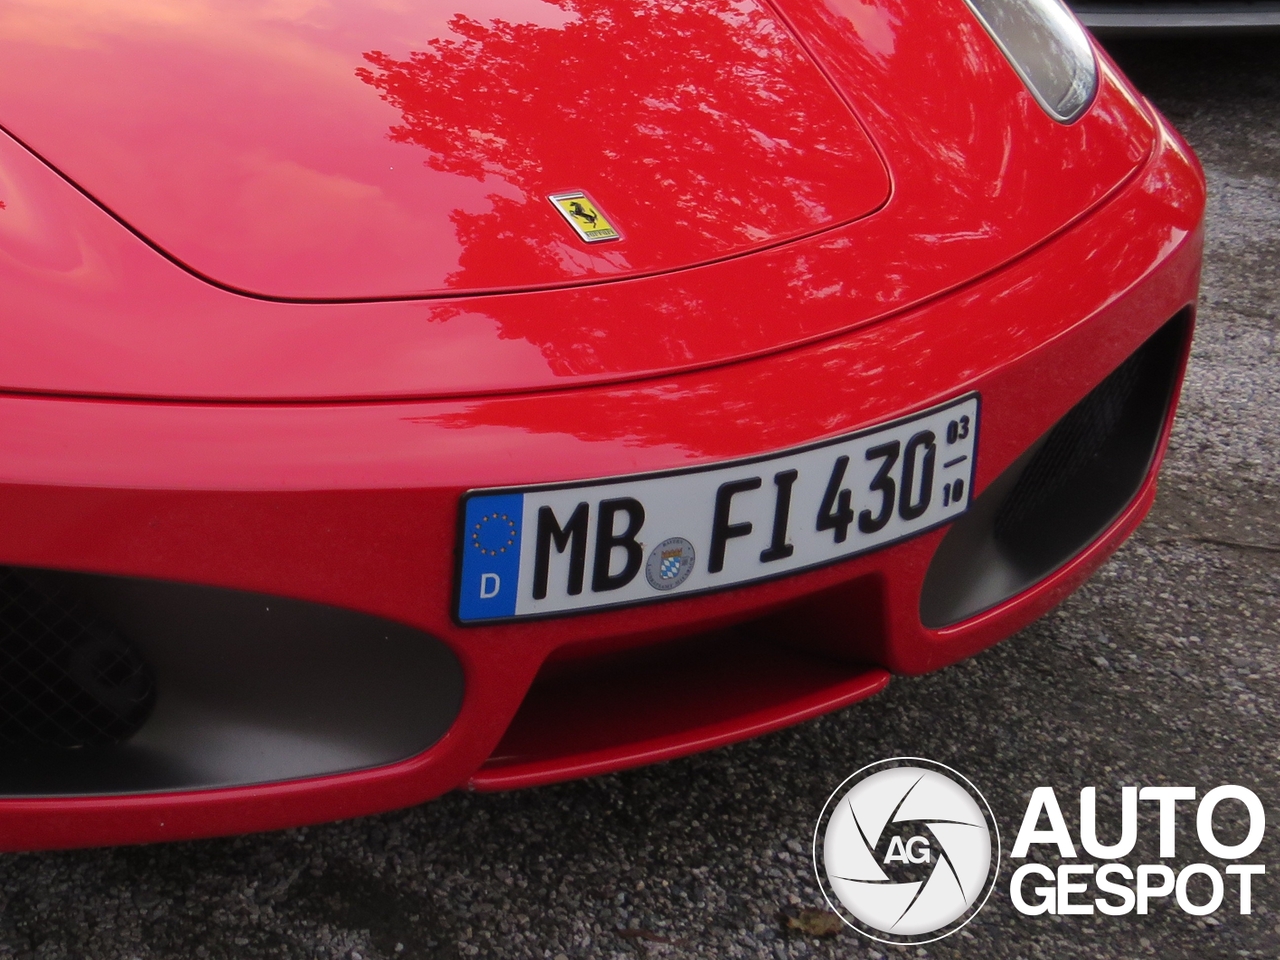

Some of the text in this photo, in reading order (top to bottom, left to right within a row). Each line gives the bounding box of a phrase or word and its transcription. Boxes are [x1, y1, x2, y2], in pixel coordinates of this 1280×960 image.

[946, 415, 970, 444] 03
[943, 478, 965, 507] 10
[480, 430, 937, 600] D MB FI 430
